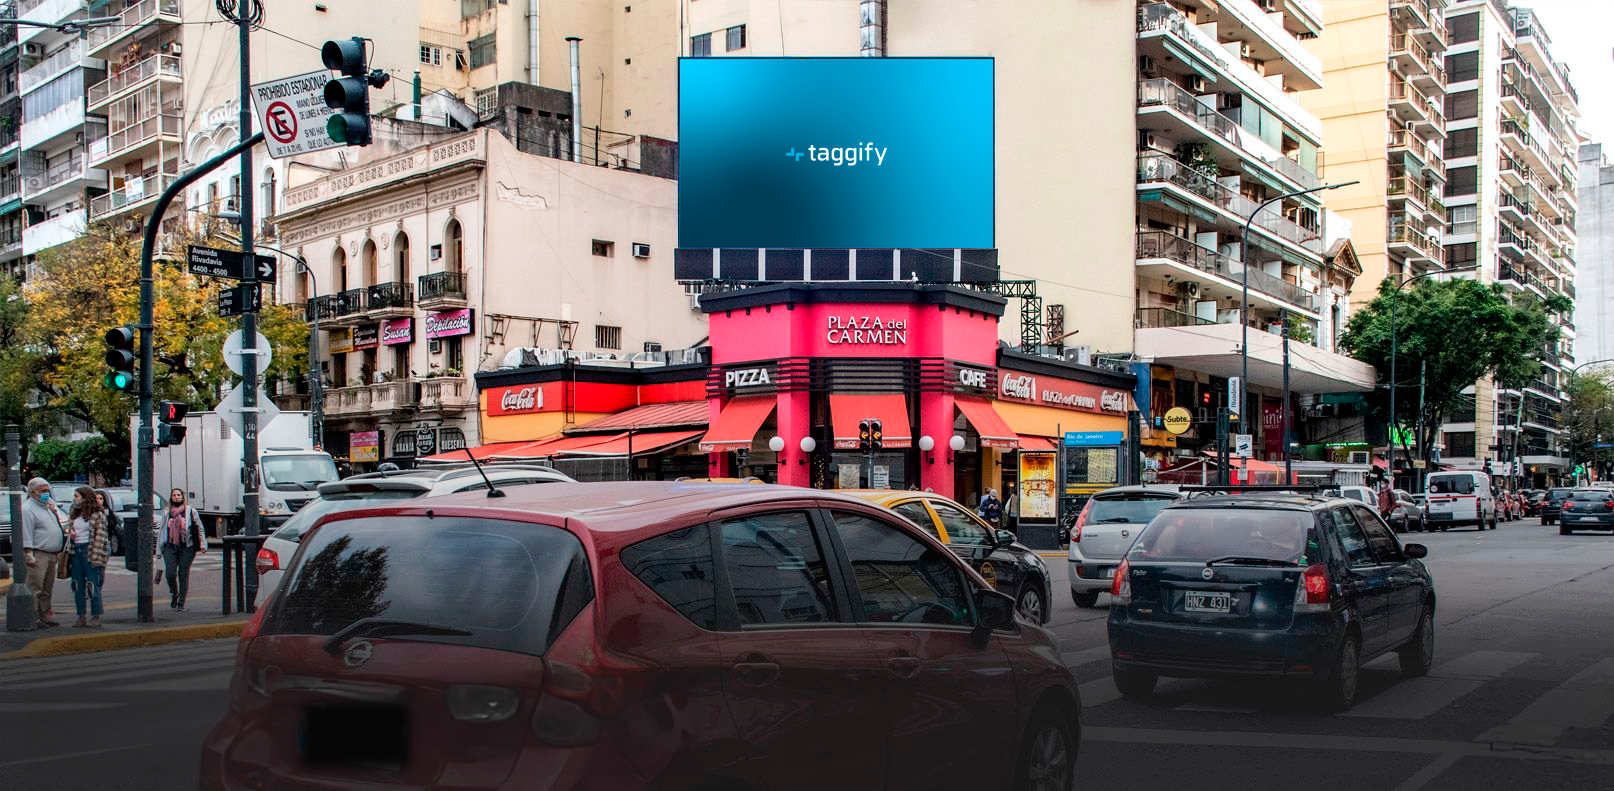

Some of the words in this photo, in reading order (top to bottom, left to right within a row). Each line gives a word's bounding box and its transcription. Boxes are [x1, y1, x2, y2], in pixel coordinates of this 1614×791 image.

[258, 82, 292, 101] PROHIBIDO
[292, 74, 328, 95] ESTACIONAR
[296, 98, 311, 109] MANO
[299, 111, 305, 120] DE
[305, 109, 316, 119] LUNES
[304, 129, 309, 138] SI
[309, 128, 316, 137] NO
[307, 140, 317, 150] QUE
[317, 138, 323, 148] LO
[808, 142, 887, 166] taggify
[192, 247, 217, 257] Avenida
[192, 255, 222, 266] Rivadavia
[193, 265, 208, 273] 4400
[213, 268, 228, 276] 4500
[425, 315, 470, 334] Depilación
[828, 316, 884, 329] PLAZA
[887, 319, 907, 329] del
[383, 324, 411, 341] Susan
[827, 330, 907, 344] CARMEN
[726, 368, 771, 388] PIZZA
[960, 369, 987, 388] CAFE
[1042, 389, 1062, 403] PLAZA
[1070, 394, 1096, 409] CARMEN
[1167, 414, 1188, 423] Subte
[396, 443, 414, 453] GRANJA
[441, 440, 464, 450] QUESERIA
[1187, 594, 1205, 608] HNZ
[1210, 595, 1228, 609] 431
